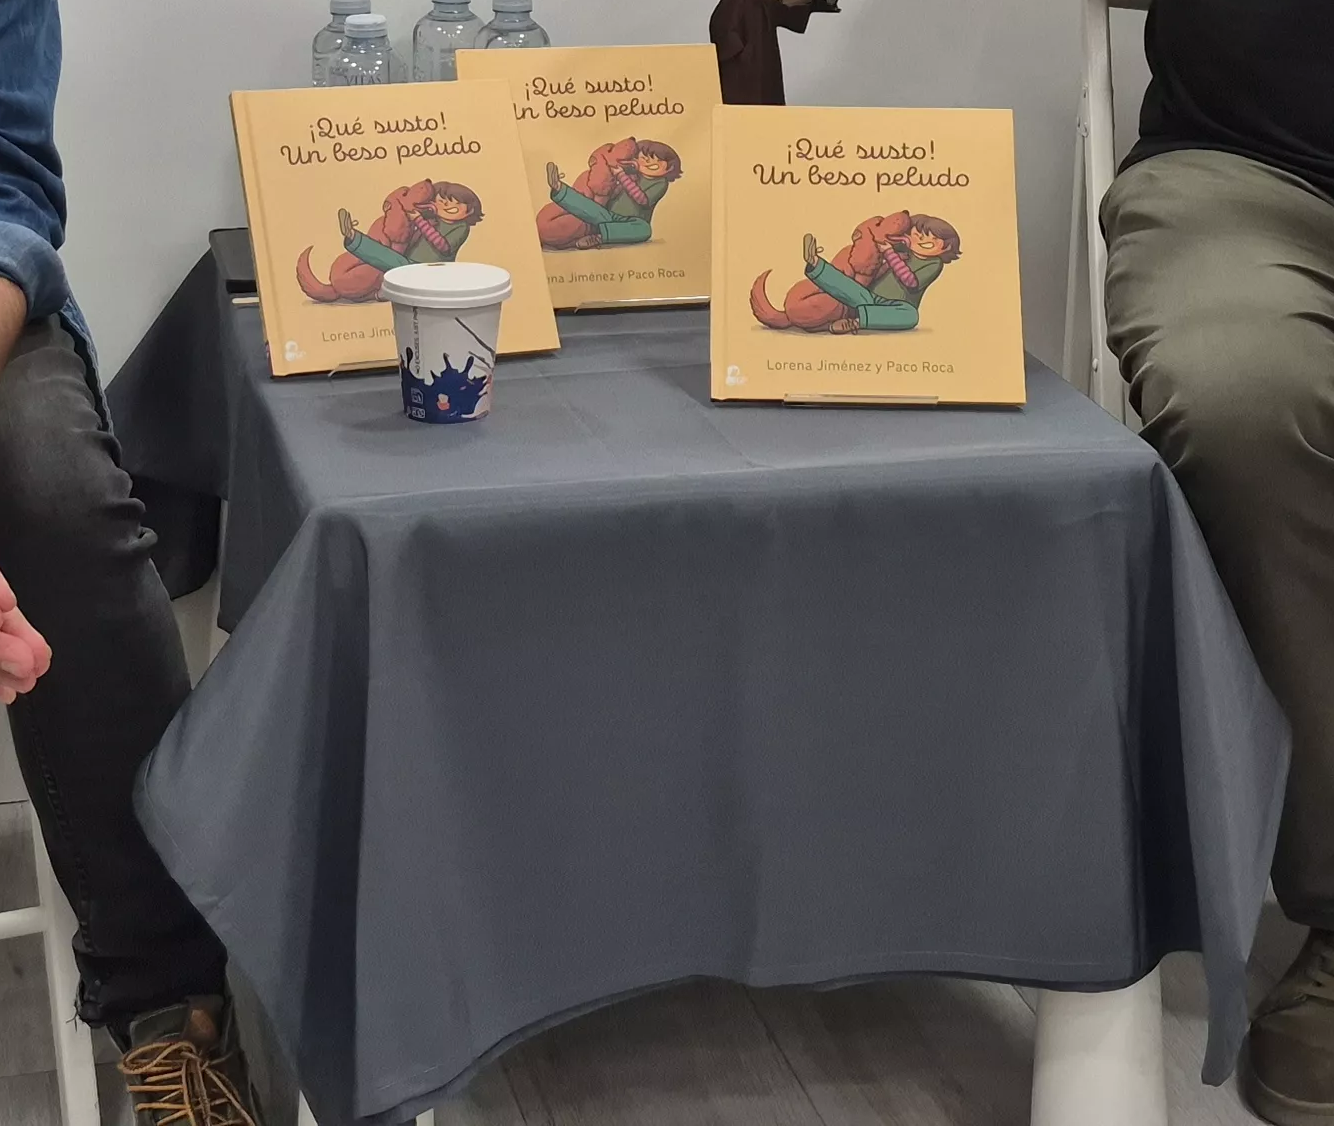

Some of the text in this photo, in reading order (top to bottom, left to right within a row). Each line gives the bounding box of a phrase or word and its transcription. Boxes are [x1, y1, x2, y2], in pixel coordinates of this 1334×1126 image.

[523, 74, 654, 100] ¡Qué susto!
[545, 99, 596, 120] beso
[604, 97, 685, 122] peludo
[308, 112, 448, 143] ¡Qué susto!
[280, 135, 482, 167] Un beso peludo
[787, 138, 935, 164] ¡Qué susto!
[753, 163, 970, 192] Un beso peludo
[568, 268, 615, 284] Jiménez
[618, 272, 625, 285] y
[628, 269, 653, 281] Paco
[656, 267, 685, 279] Roca
[322, 329, 365, 343] Lorena
[767, 358, 954, 374] Lorena Jiménez y Paco Roca
